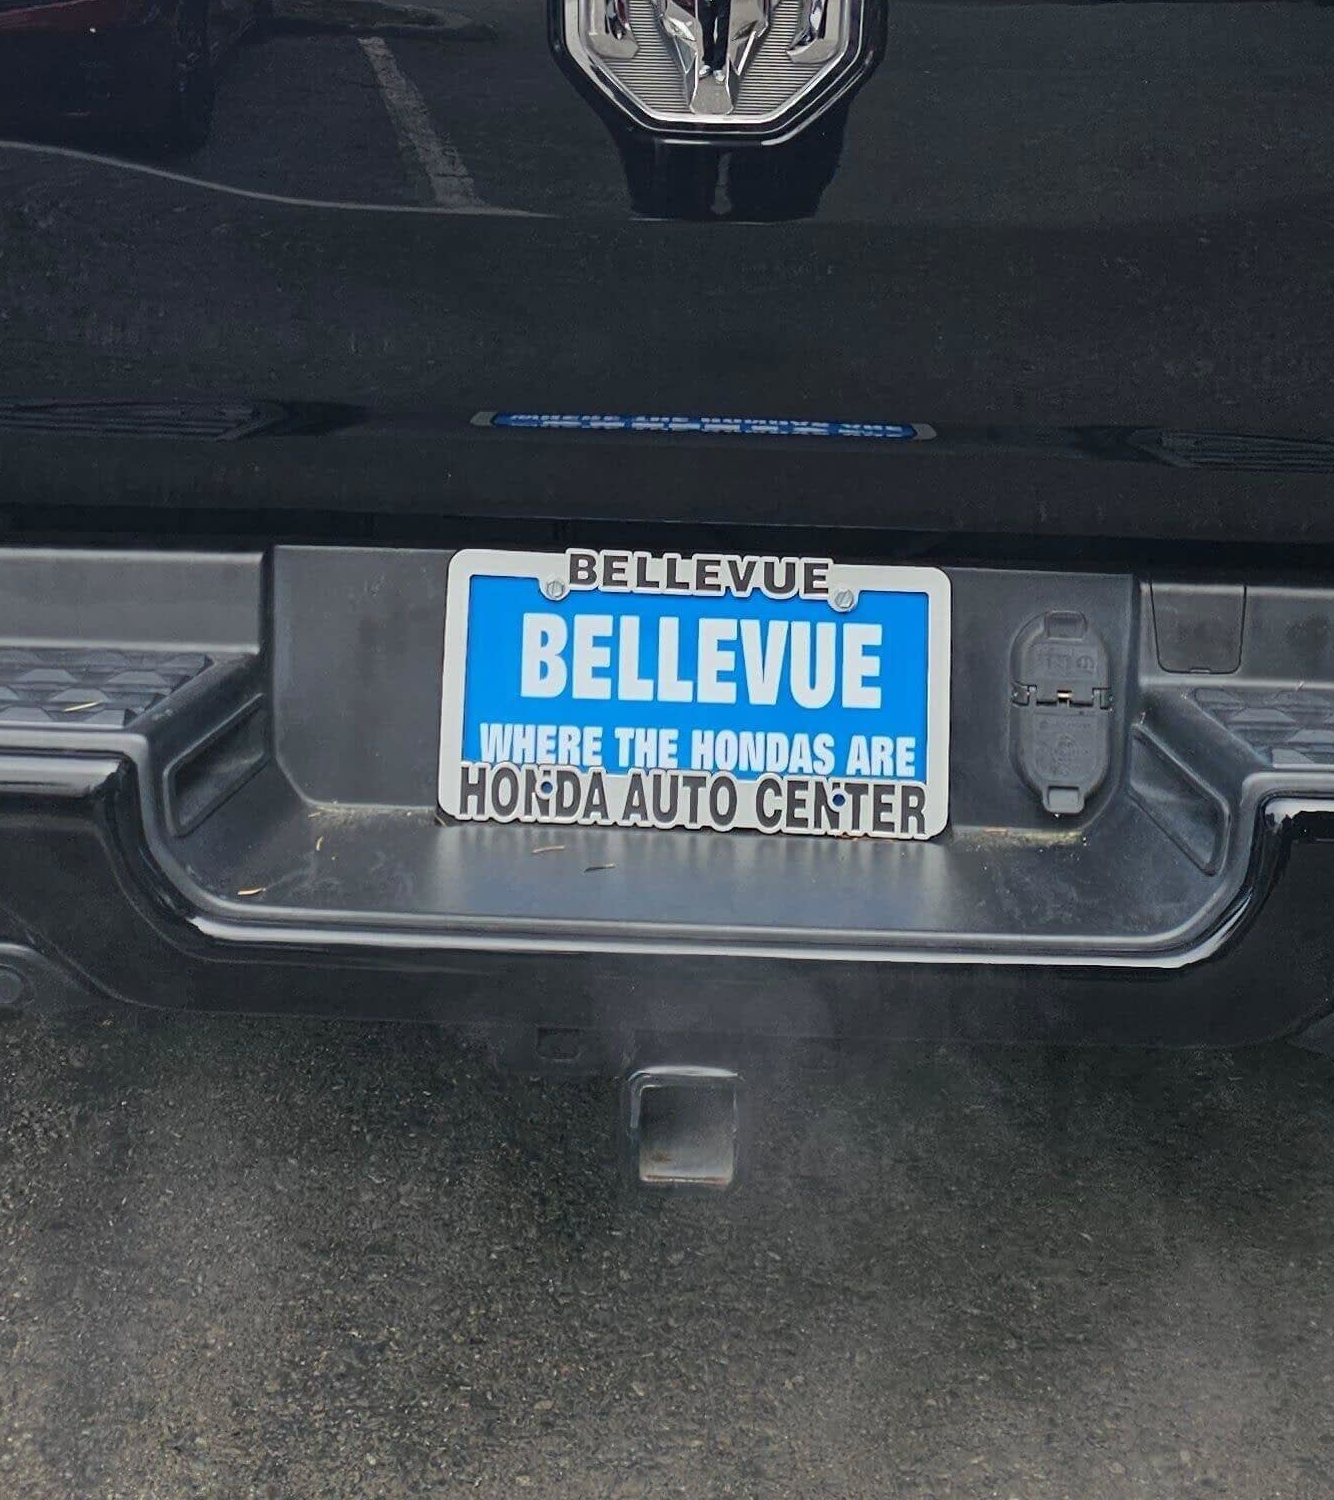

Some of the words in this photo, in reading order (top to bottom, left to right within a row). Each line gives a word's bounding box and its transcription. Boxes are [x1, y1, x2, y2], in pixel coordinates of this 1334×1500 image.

[568, 553, 831, 595] BELLEVUE
[520, 612, 883, 709] BELLEVUE
[479, 722, 604, 767] WHERE
[614, 726, 679, 770] THE
[690, 729, 835, 776] HONDAS
[846, 734, 916, 777] ARE
[459, 762, 609, 822] HONDA
[622, 771, 738, 826] AUTO
[755, 777, 927, 835] CENTER
